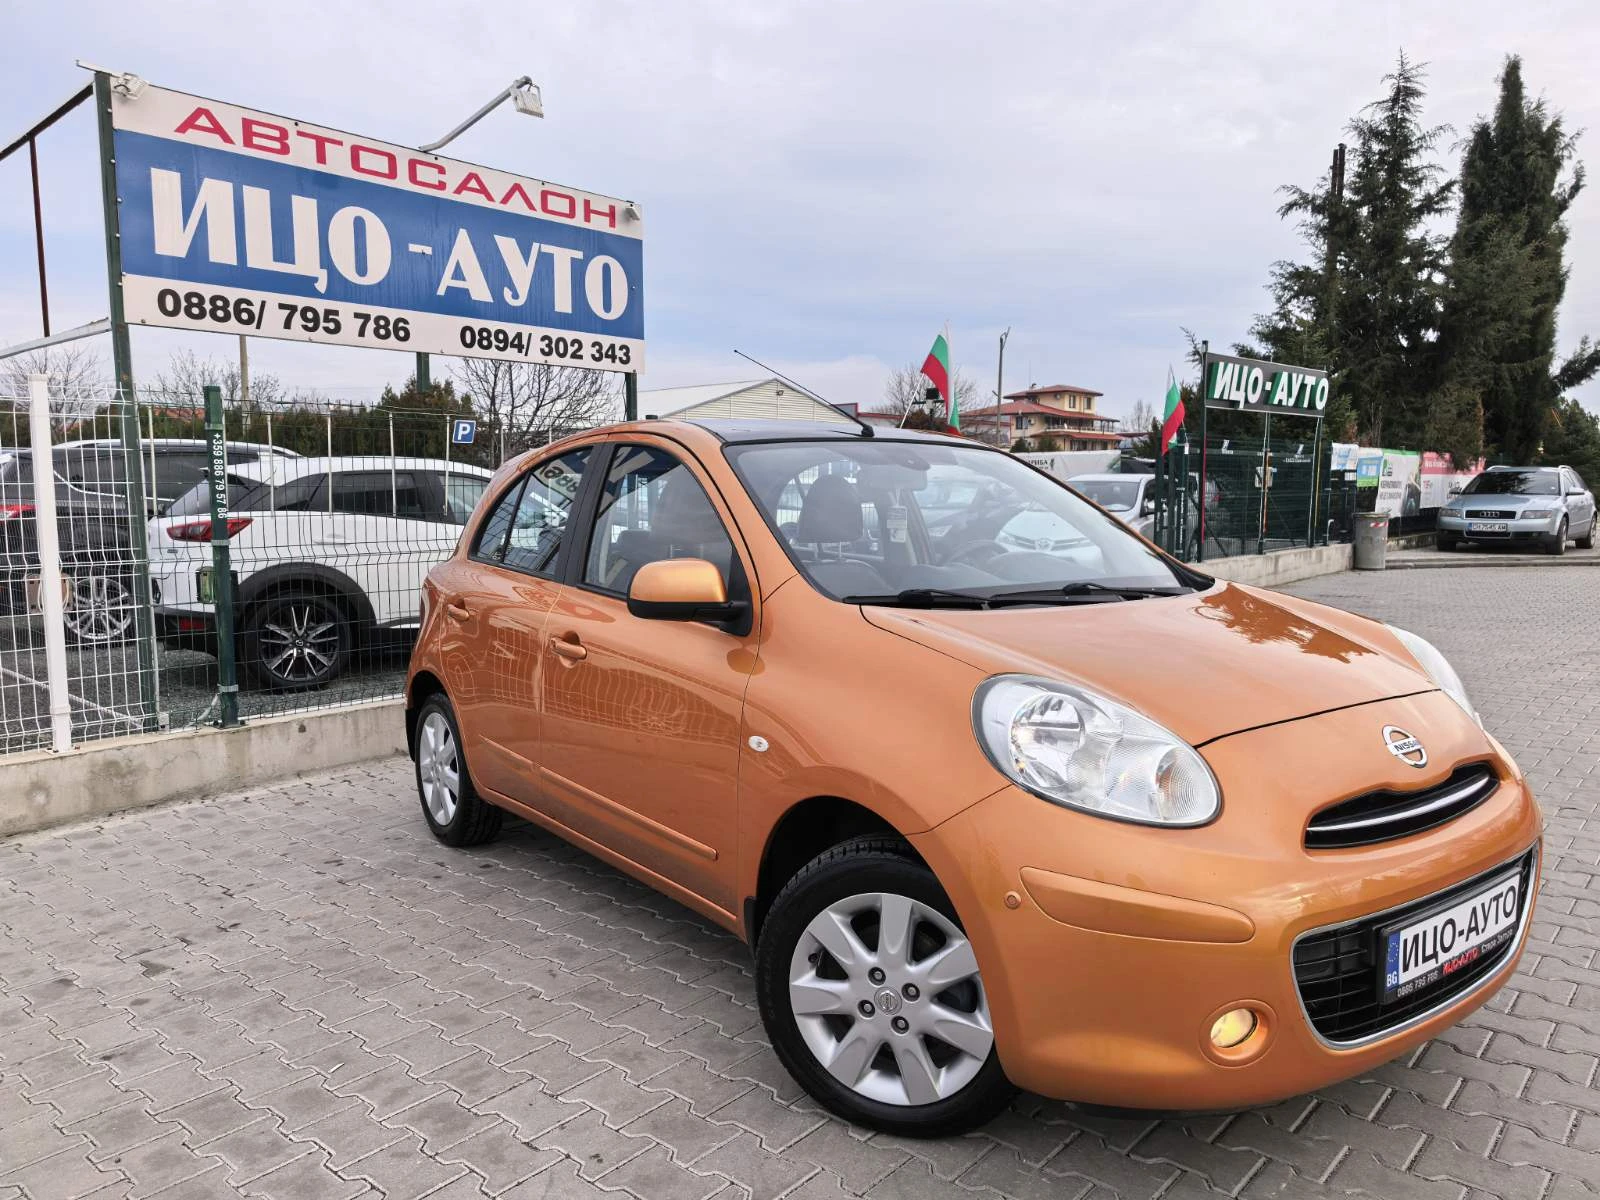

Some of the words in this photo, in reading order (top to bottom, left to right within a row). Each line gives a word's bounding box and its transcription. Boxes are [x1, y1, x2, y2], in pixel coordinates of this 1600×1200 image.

[174, 107, 617, 228] АВТОСАЛОН
[157, 287, 265, 329] 0886/
[277, 302, 341, 335] 795
[353, 311, 411, 343] 786
[460, 325, 533, 355] 0894/
[539, 335, 584, 361] 302
[590, 341, 631, 365] 343
[1213, 361, 1330, 411] ИЦО-АУТО
[457, 423, 471, 441] P
[212, 432, 223, 456] +359
[213, 459, 224, 476] 886
[215, 479, 225, 491] 79
[215, 493, 226, 504] 57
[217, 507, 227, 518] 86
[1393, 740, 1420, 751] NISS
[1402, 885, 1516, 974] ИЦО-АУТО
[1386, 971, 1398, 988] BG
